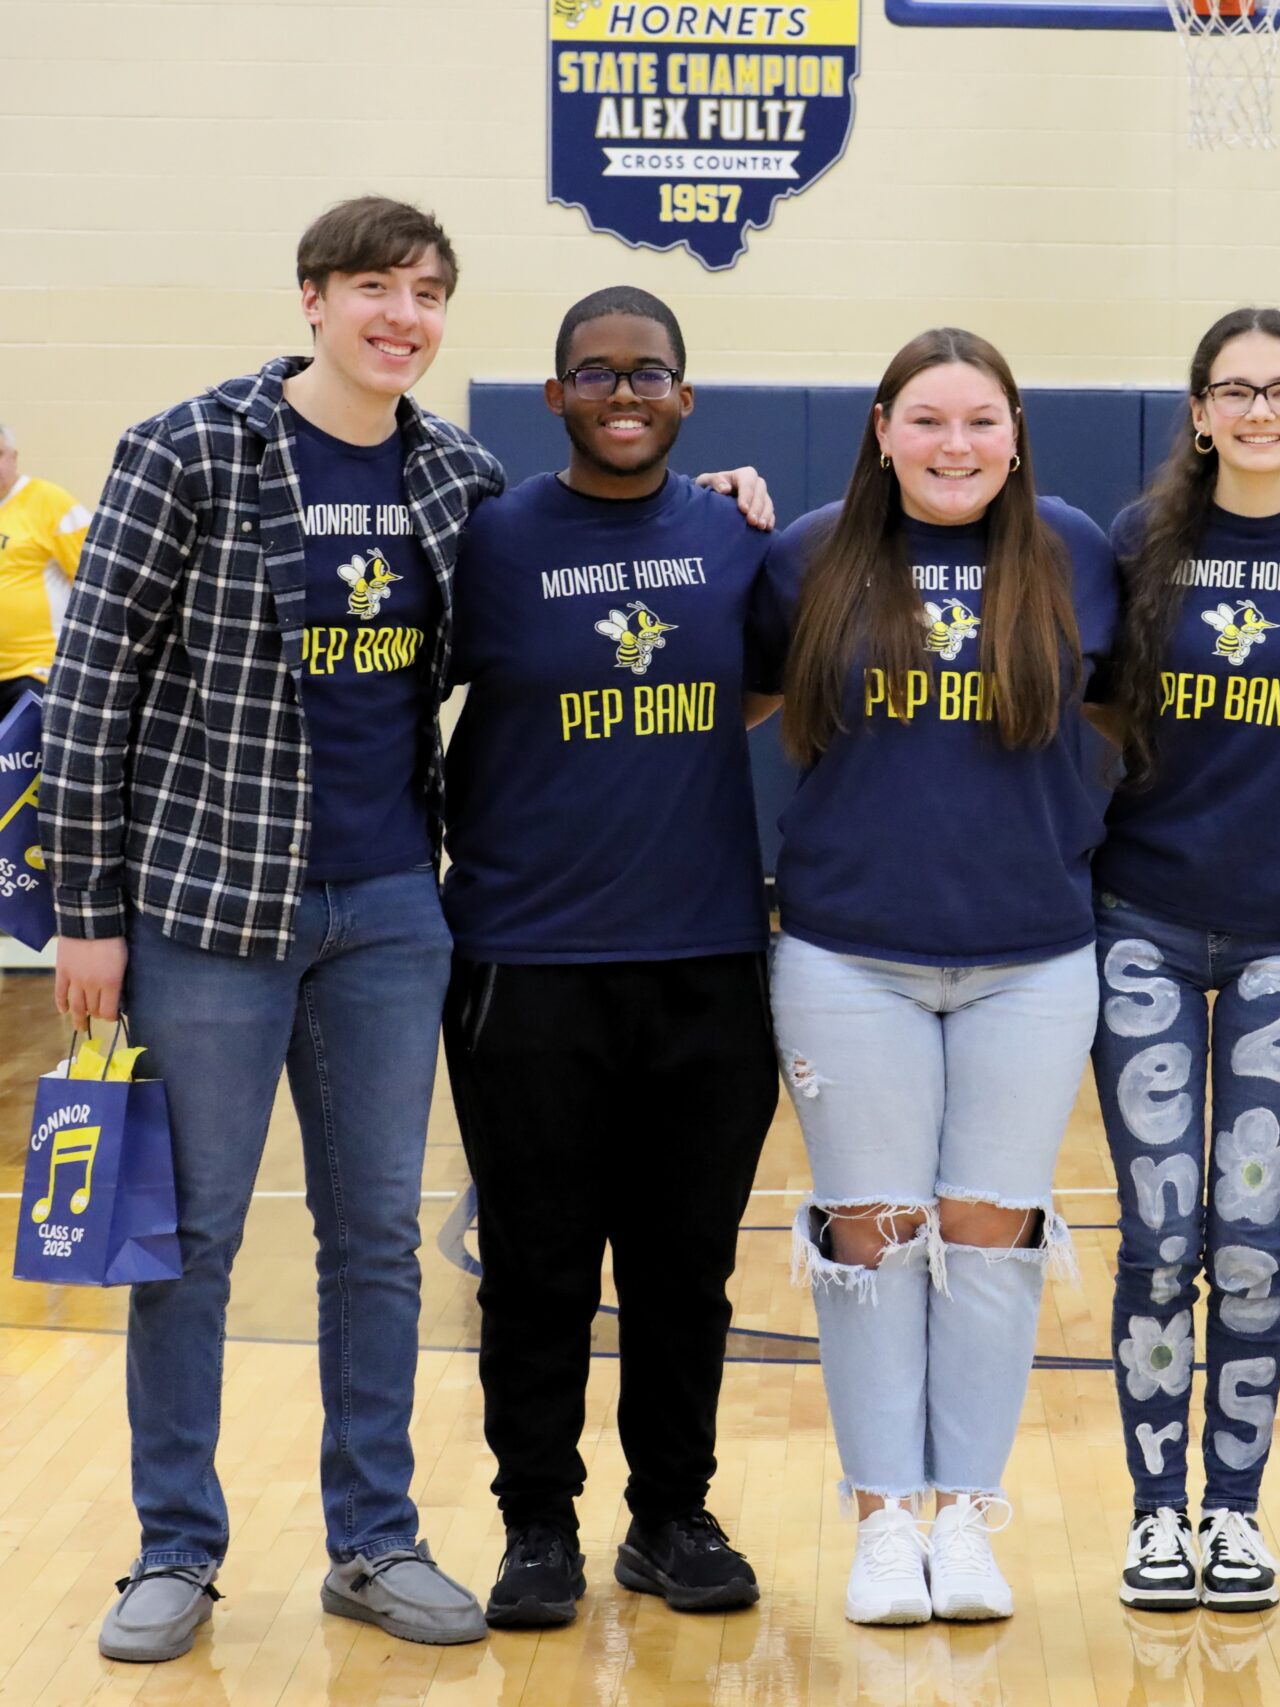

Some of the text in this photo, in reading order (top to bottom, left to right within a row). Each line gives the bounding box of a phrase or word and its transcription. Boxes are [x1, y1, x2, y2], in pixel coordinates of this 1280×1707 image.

[607, 5, 807, 36] HORNETS
[558, 51, 845, 97] STATE CHAMPION
[595, 98, 806, 141] ALEX FULTZ
[621, 154, 783, 172] CROSS COUNTRY
[659, 183, 742, 222] 1957
[301, 504, 416, 535] MONROE HOR
[540, 557, 706, 599] MONROE HORNET
[909, 564, 949, 590] ROE
[559, 682, 716, 742] PEP BAND
[1160, 671, 1216, 719] PEP
[31, 1104, 91, 1151] CONNOR
[38, 1223, 85, 1243] CLASS OF
[42, 1239, 72, 1257] 2025
